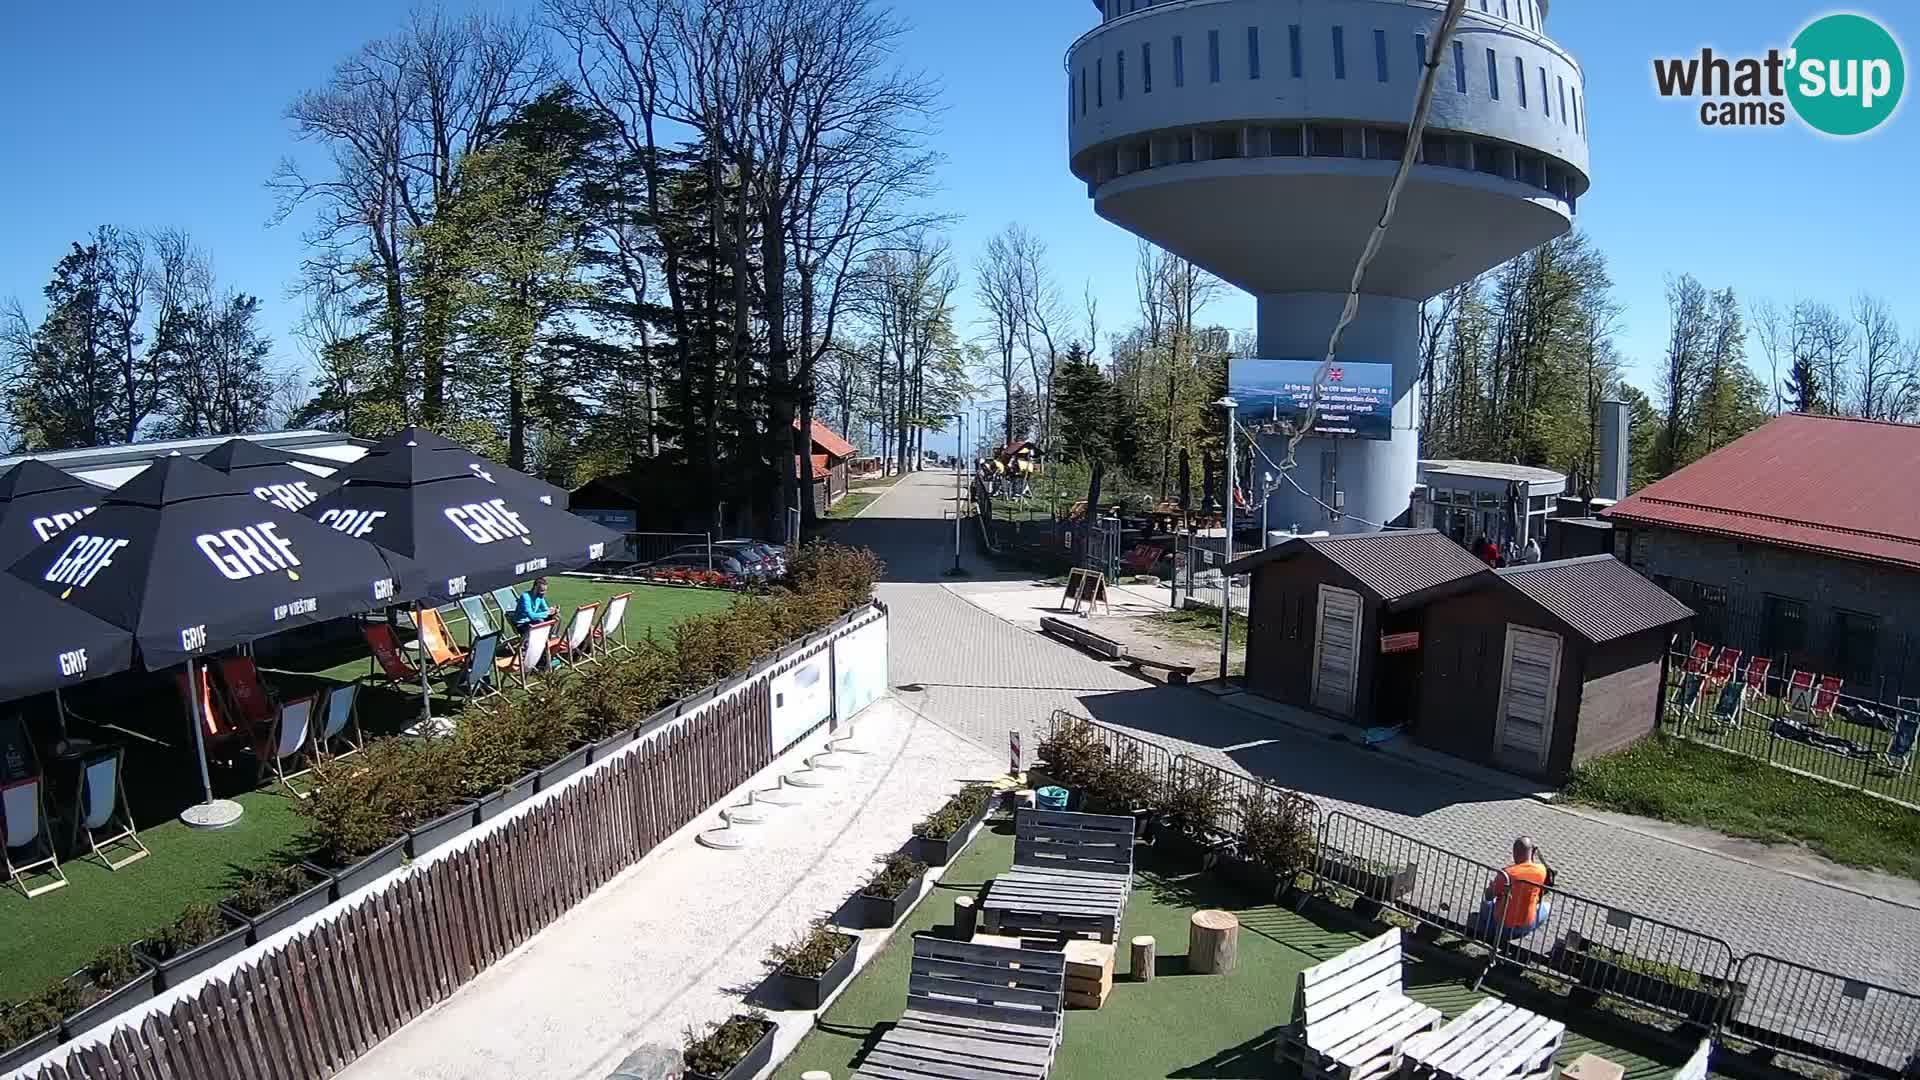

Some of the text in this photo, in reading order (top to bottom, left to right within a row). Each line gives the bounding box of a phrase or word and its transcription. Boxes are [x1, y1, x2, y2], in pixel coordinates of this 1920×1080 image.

[444, 499, 530, 544] GRIF
[45, 535, 130, 587] GRIF
[196, 521, 301, 580] GRIF
[374, 578, 393, 600] GRIF
[448, 576, 467, 595] GRIF
[182, 625, 208, 651] GRIF
[59, 648, 88, 676] GRIF
